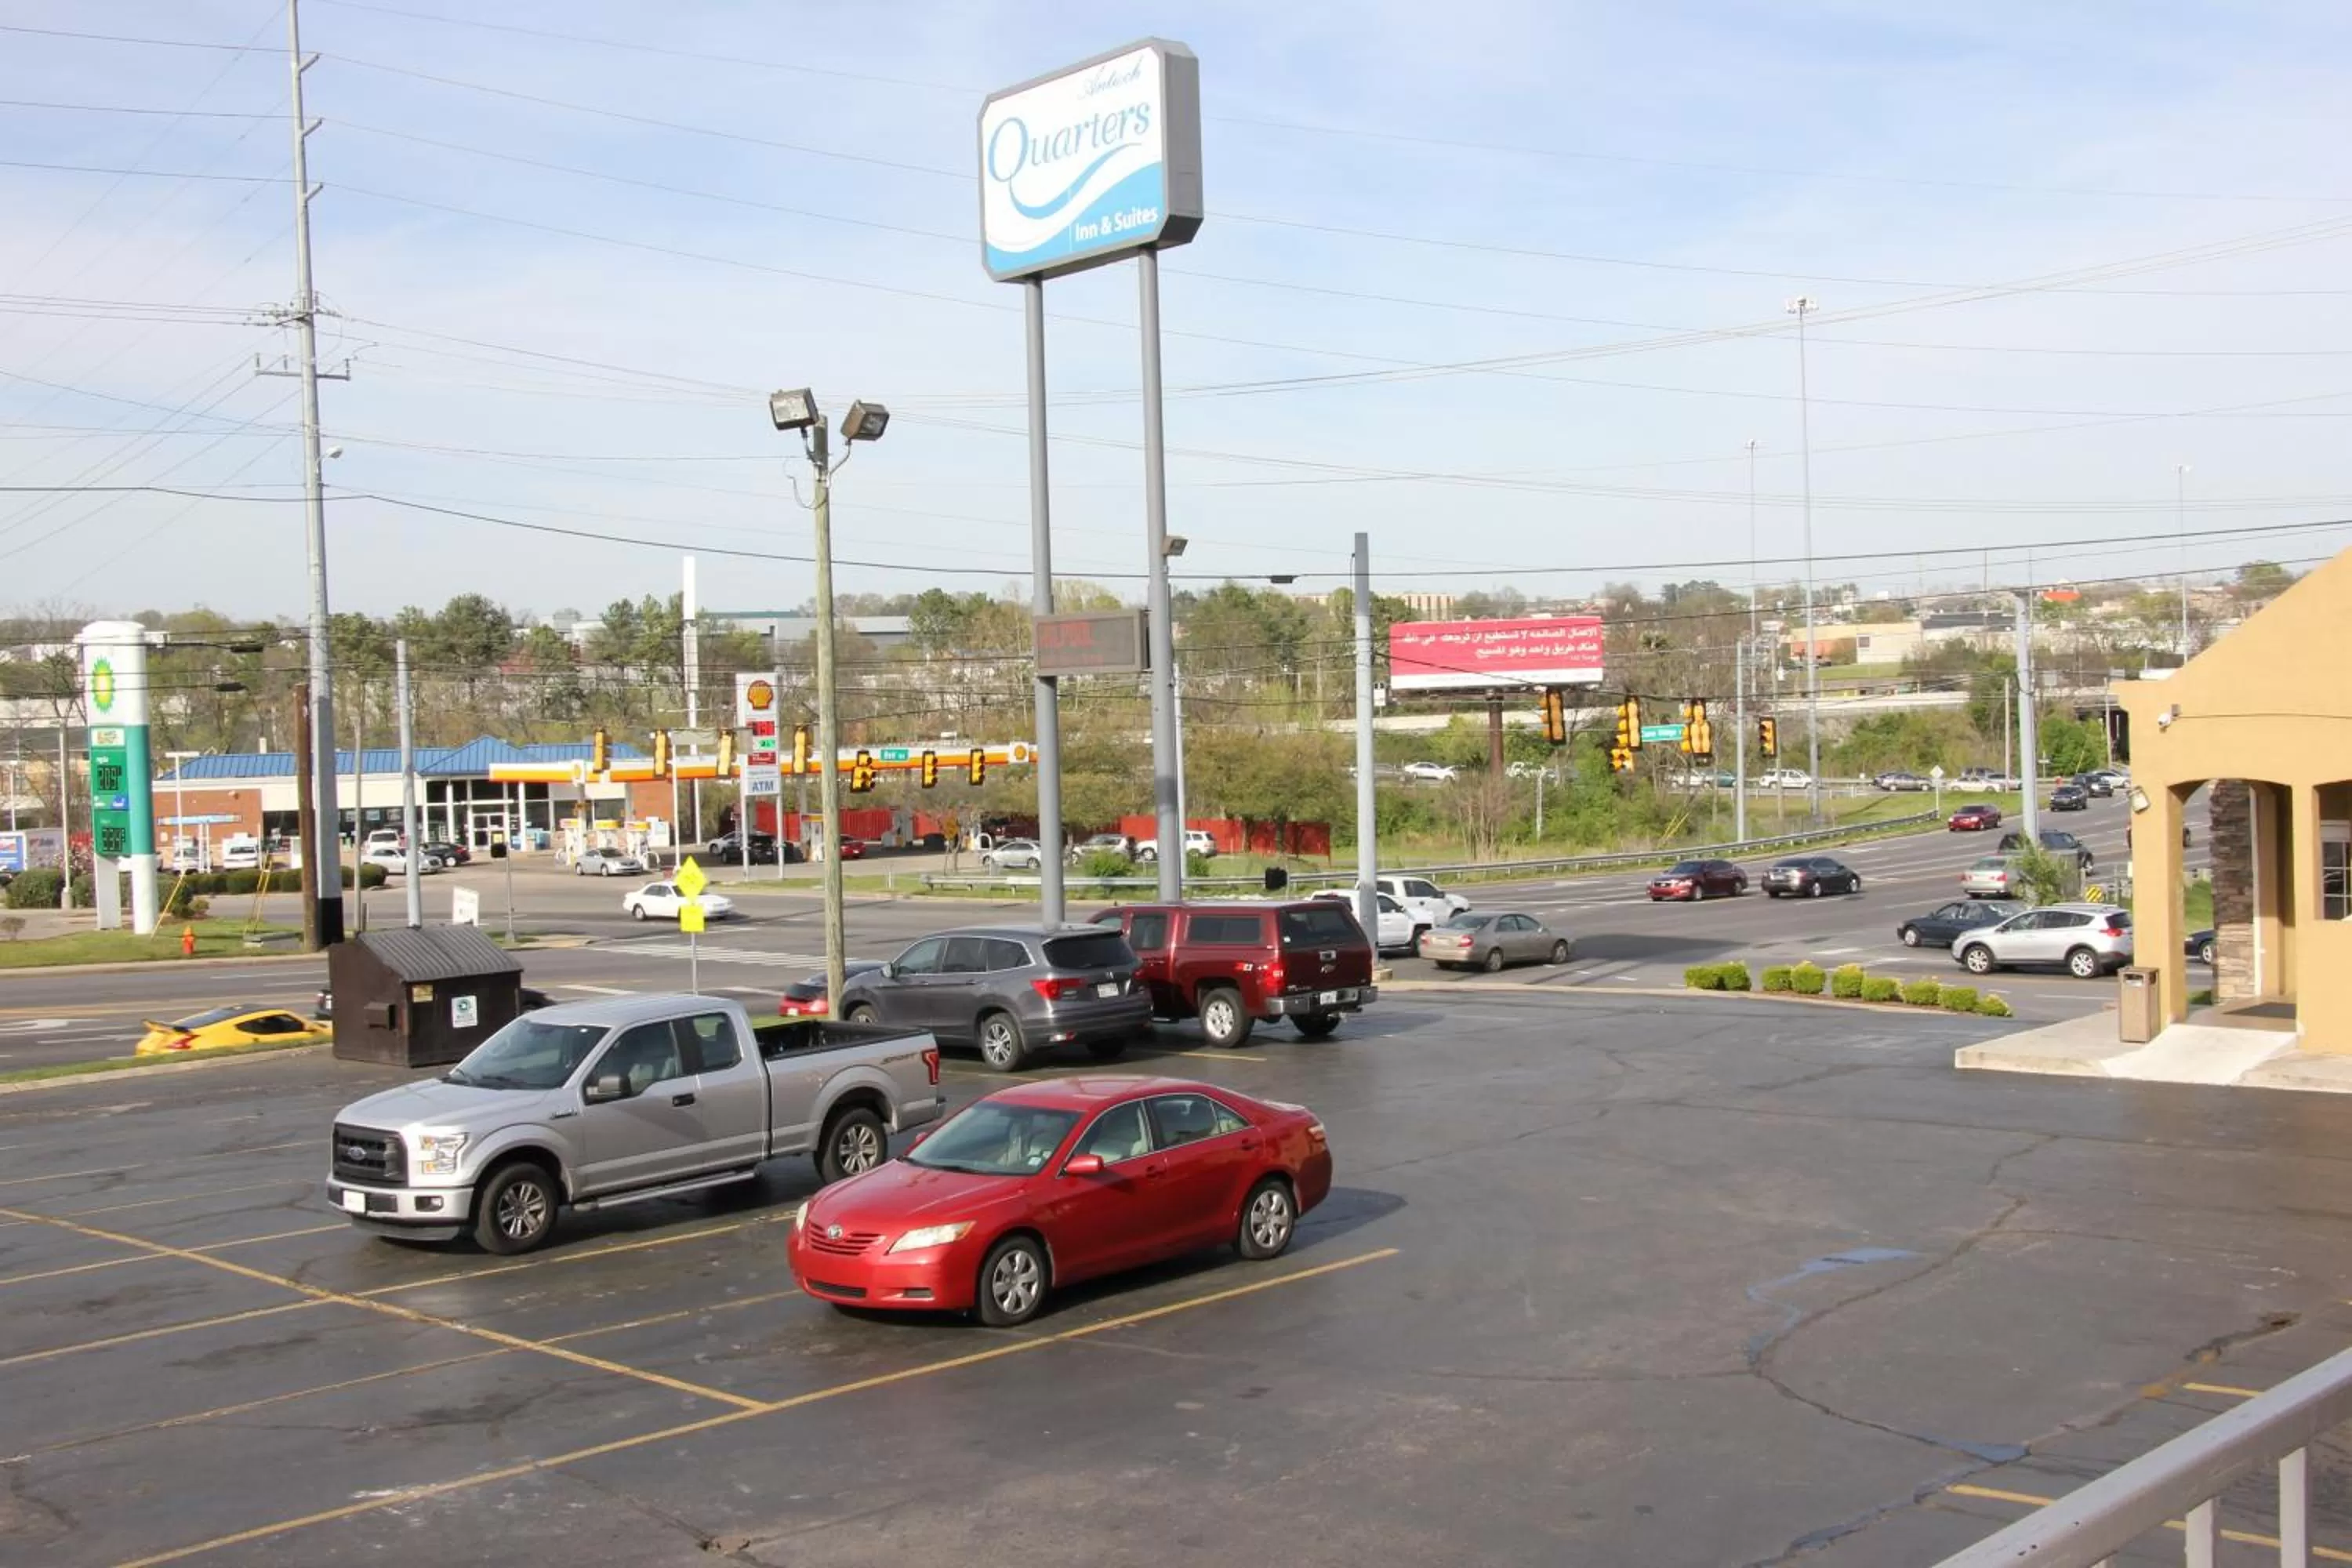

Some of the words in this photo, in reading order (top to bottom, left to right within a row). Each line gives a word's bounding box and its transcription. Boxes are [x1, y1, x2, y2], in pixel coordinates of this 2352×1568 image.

[988, 102, 1151, 183] Quarters
[1076, 222, 1098, 241] Inn
[1101, 216, 1112, 234] &
[1114, 205, 1159, 232] Suites
[752, 780, 774, 793] ATM
